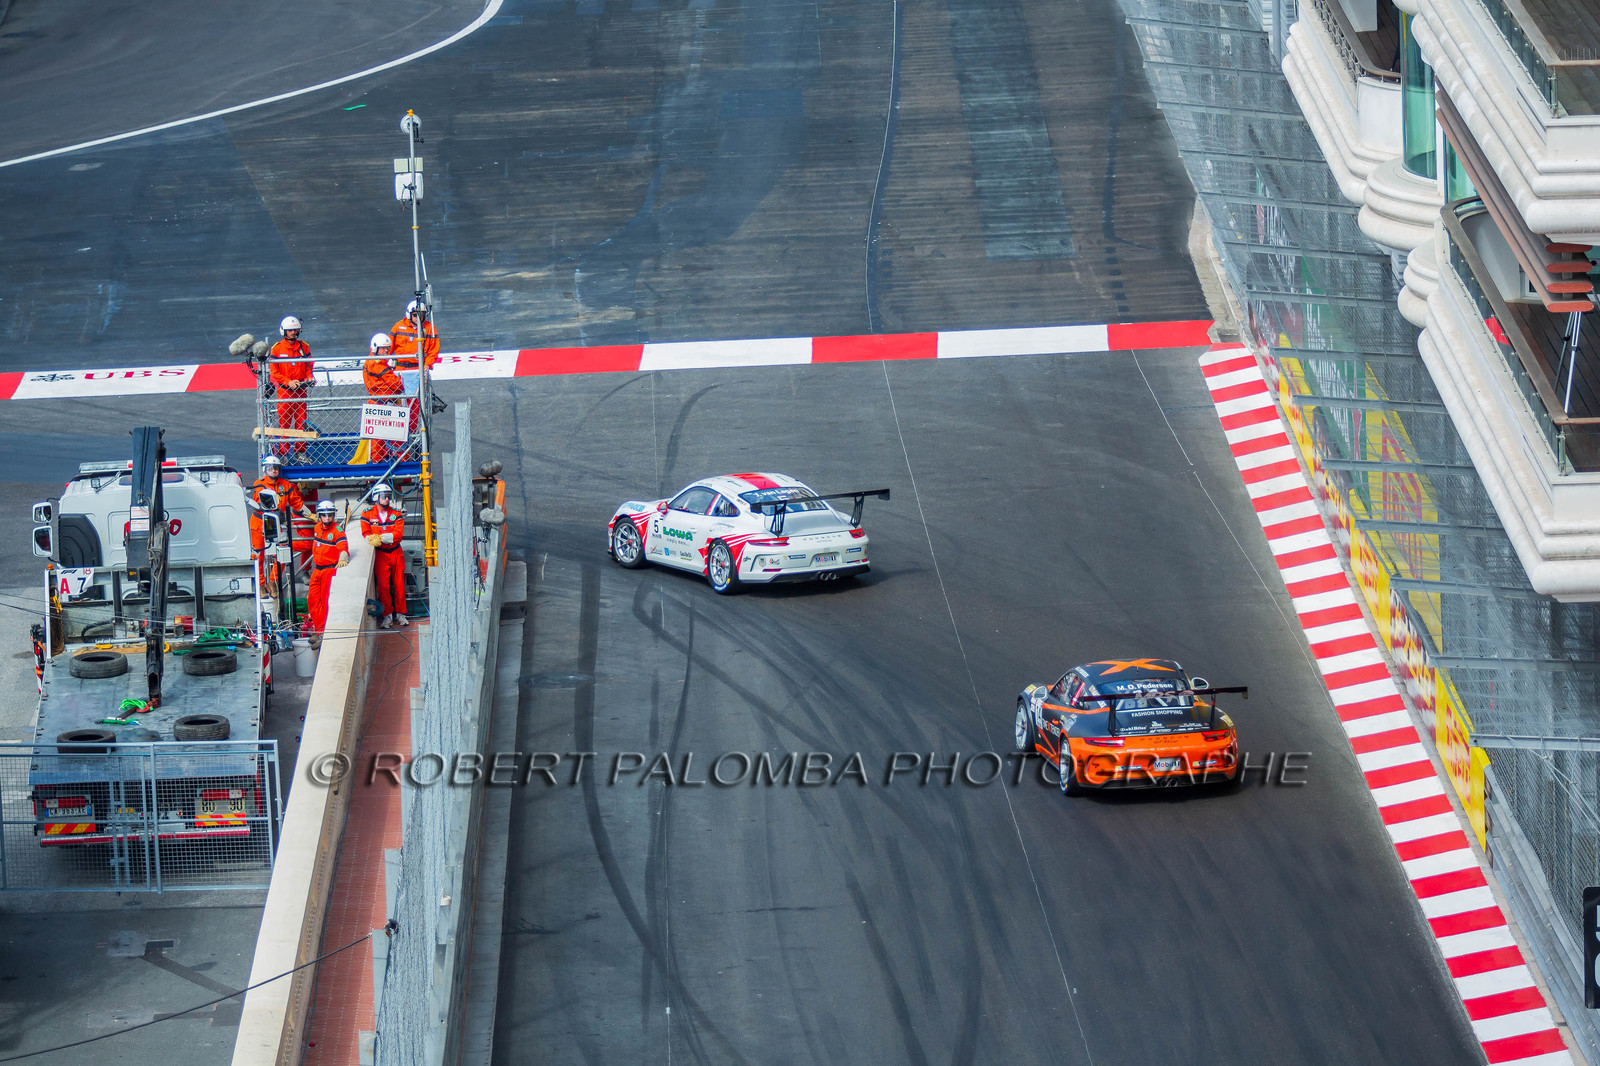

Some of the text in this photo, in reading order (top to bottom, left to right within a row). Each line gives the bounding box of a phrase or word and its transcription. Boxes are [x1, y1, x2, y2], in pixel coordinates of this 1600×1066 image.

[82, 368, 185, 380] UBS
[365, 408, 392, 416] SECTEUR
[365, 418, 405, 428] INTERVENTION
[365, 426, 375, 435] 10
[653, 520, 660, 533] 5
[662, 526, 693, 541] LOWA
[60, 577, 87, 595] A 7
[229, 798, 243, 811] 90
